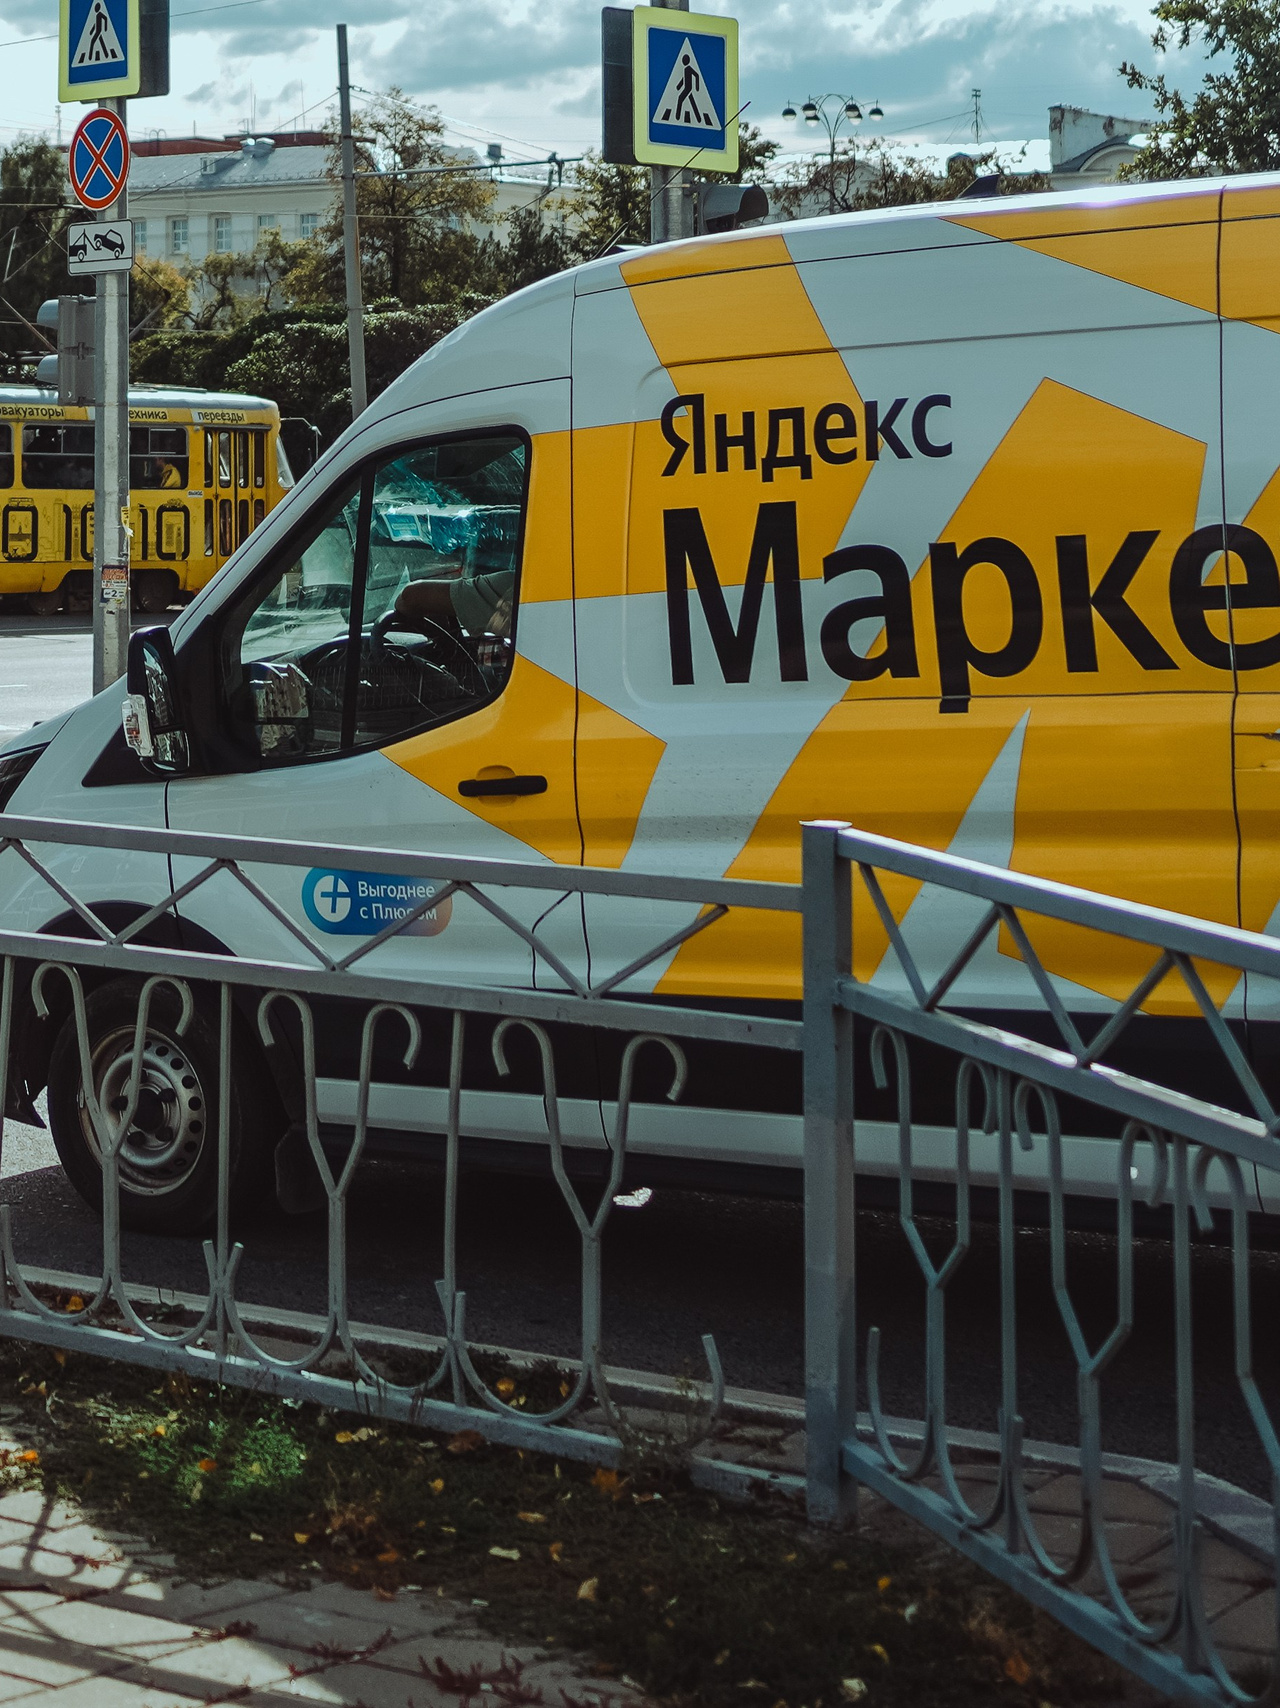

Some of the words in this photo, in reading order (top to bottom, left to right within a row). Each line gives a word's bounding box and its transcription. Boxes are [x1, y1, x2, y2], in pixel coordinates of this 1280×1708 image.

[128, 410, 168, 420] ехника
[197, 411, 245, 423] переезды
[660, 393, 953, 482] Яндекс
[662, 501, 1280, 714] Марке
[357, 881, 436, 900] Выгоднее
[360, 908, 369, 919] с
